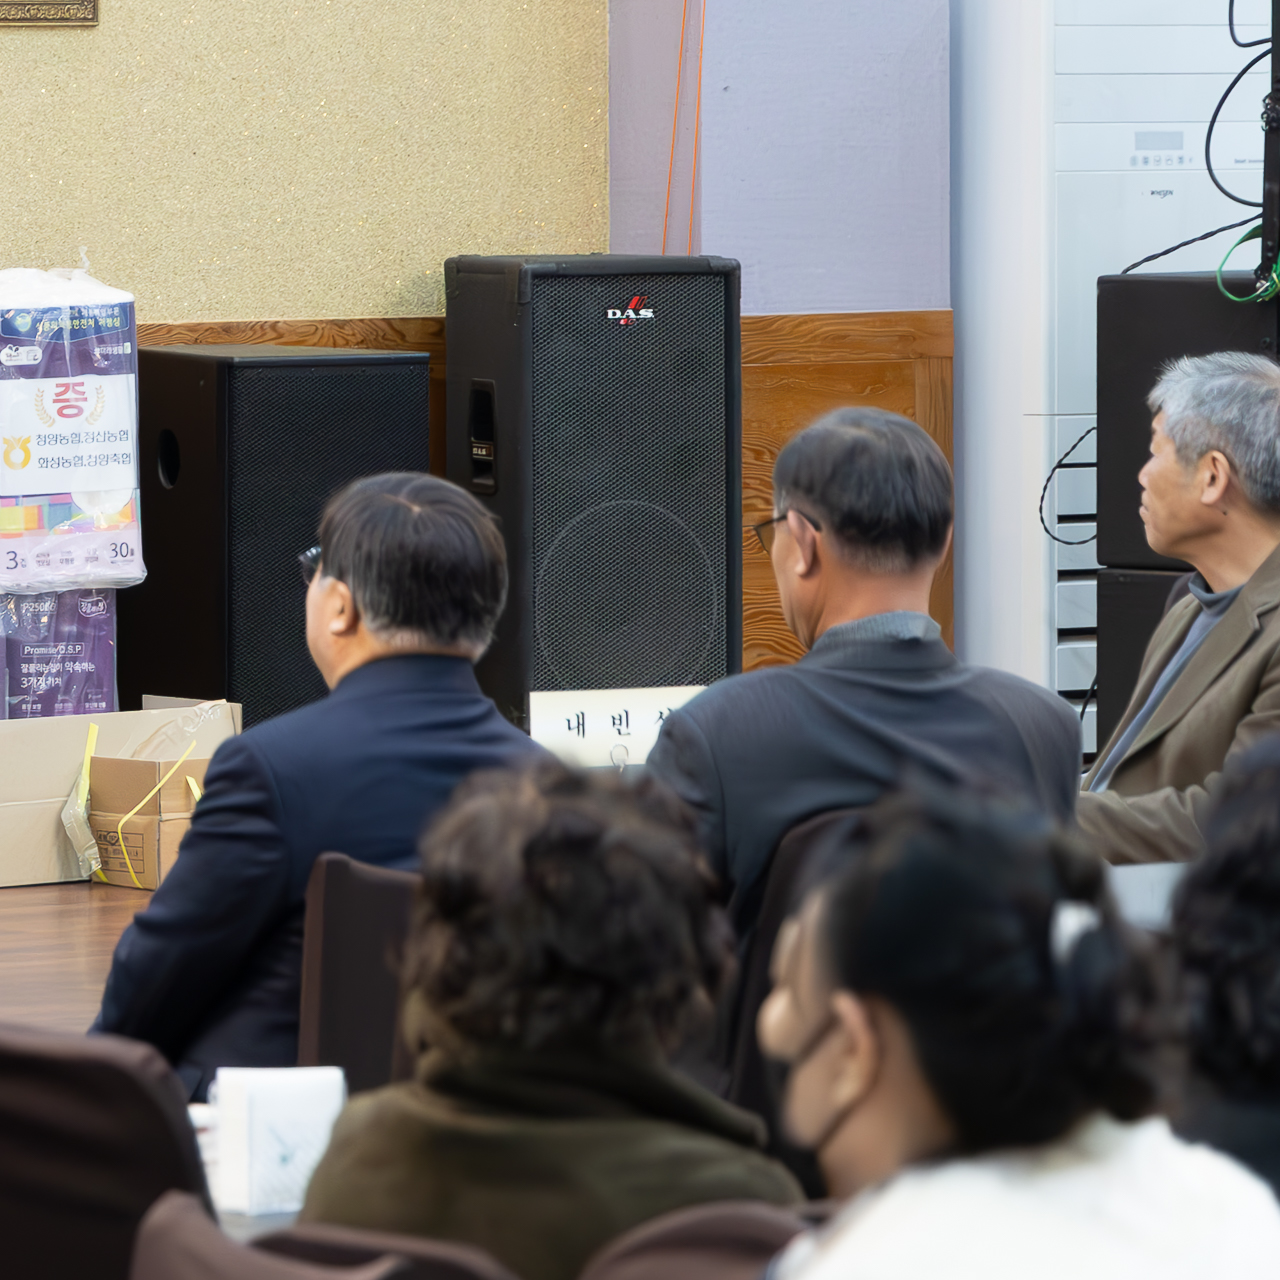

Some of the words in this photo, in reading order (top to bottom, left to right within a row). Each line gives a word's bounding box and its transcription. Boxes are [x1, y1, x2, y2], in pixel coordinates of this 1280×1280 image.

[52, 381, 89, 419] 증
[35, 429, 130, 447] 청양농협.정산농협
[37, 452, 132, 469] 화성농협.청양축협
